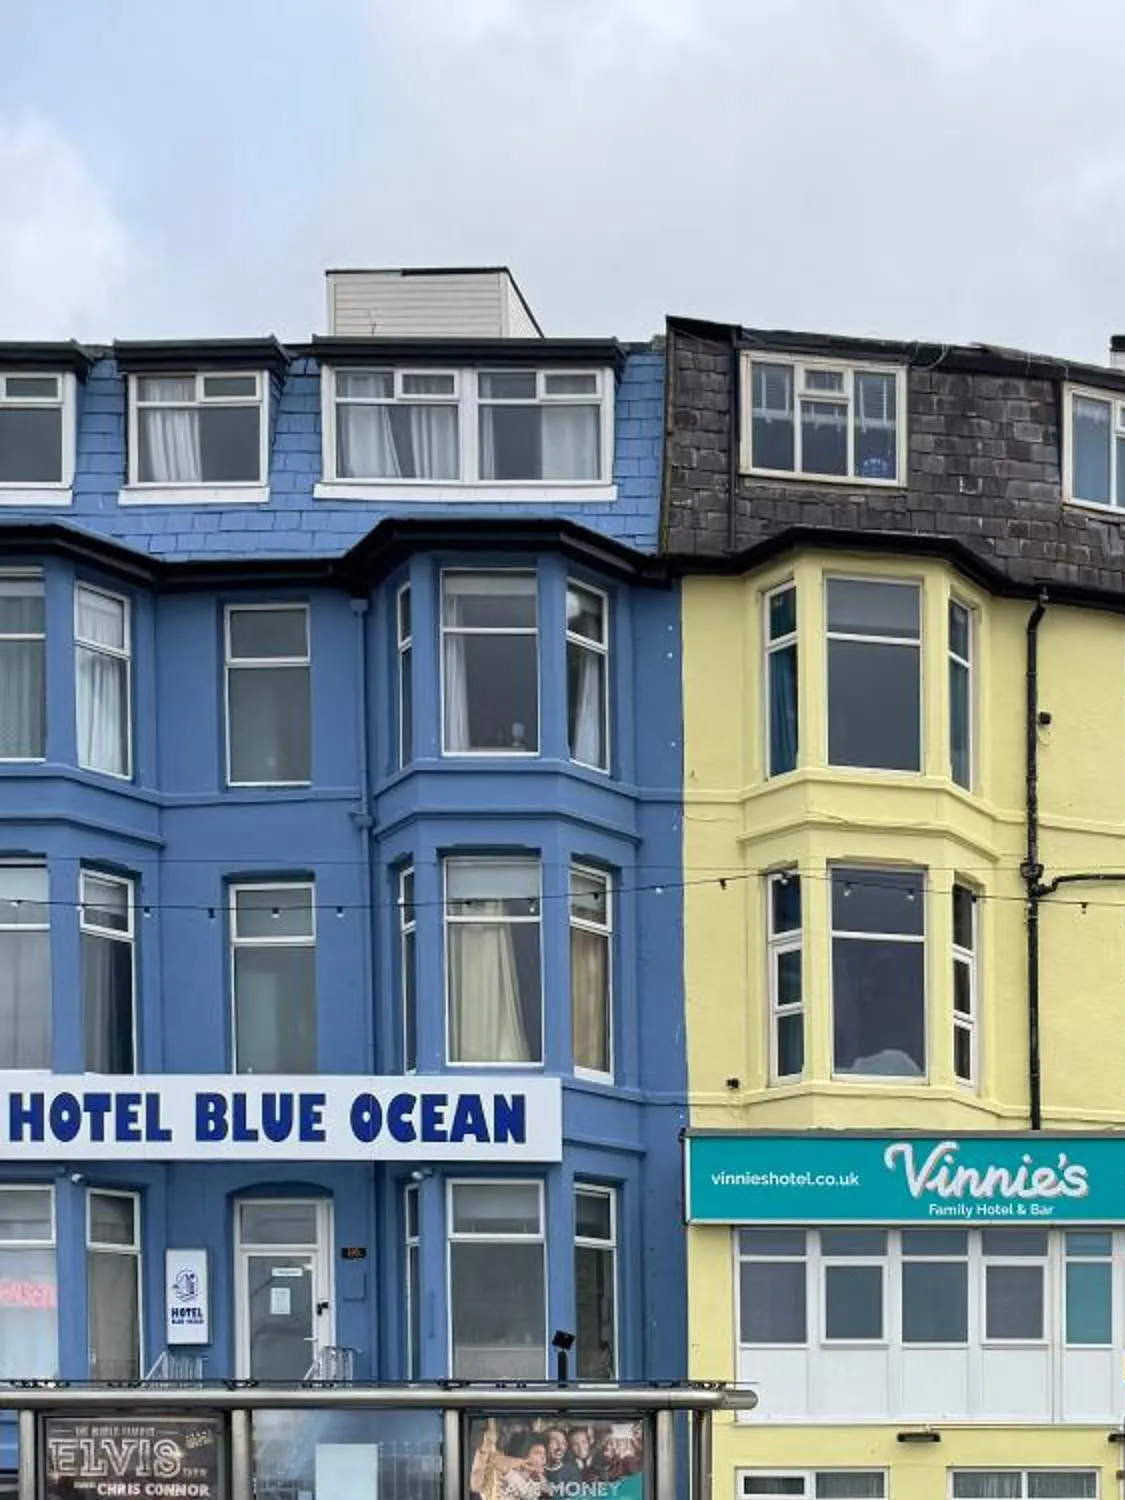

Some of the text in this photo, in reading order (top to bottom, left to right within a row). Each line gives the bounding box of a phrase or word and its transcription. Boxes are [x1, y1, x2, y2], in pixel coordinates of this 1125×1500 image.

[9, 1092, 526, 1144] HOTEL BLUE OCEAN
[883, 1141, 1090, 1199] Vinnie's
[711, 1171, 860, 1186] vinnieshotel.co.uk
[928, 1203, 1055, 1219] Family Hotel & Bar
[172, 1307, 203, 1318] HOTEL
[48, 1438, 181, 1478] ELVIS
[97, 1482, 210, 1497] CHRIS CONNOR
[550, 1481, 623, 1497] MONEY
